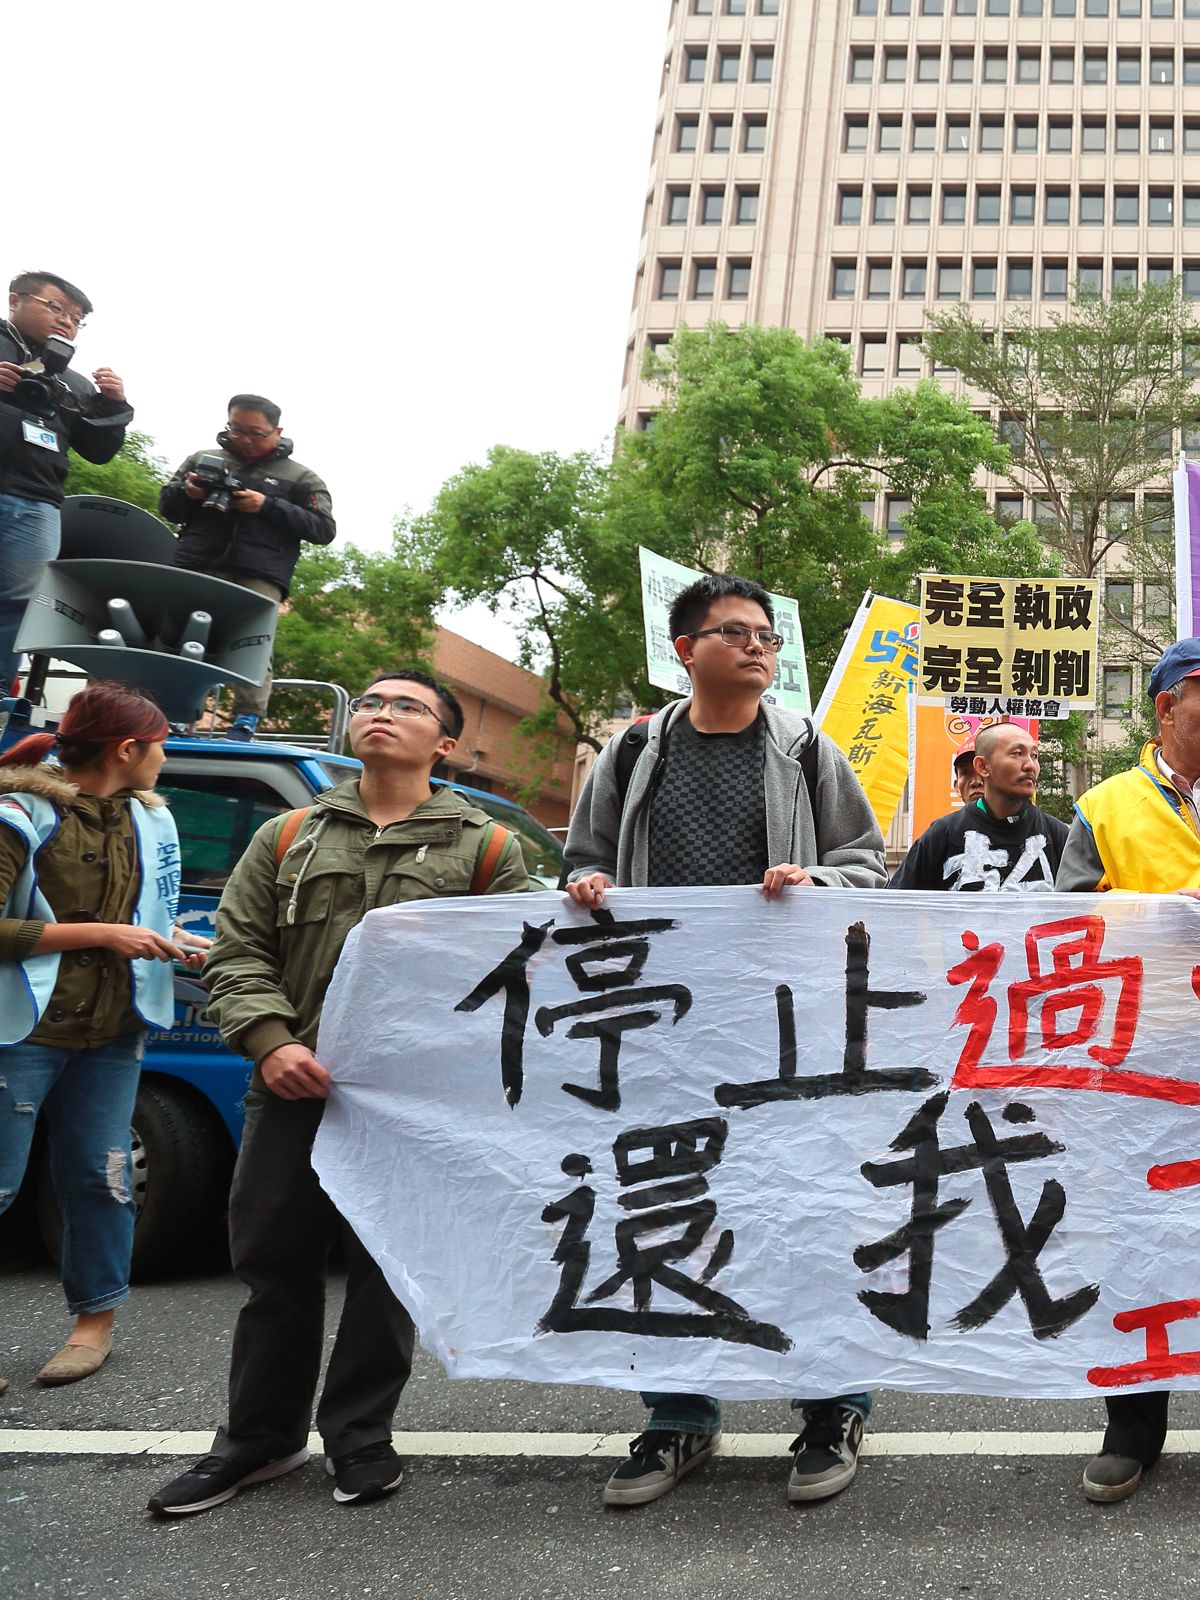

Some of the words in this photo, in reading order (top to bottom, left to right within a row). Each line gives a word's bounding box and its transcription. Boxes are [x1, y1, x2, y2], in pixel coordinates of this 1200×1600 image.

[925, 579, 1093, 631] 完全執政
[922, 644, 1091, 697] 完全剝削
[950, 695, 1061, 718] 勞動人權協會
